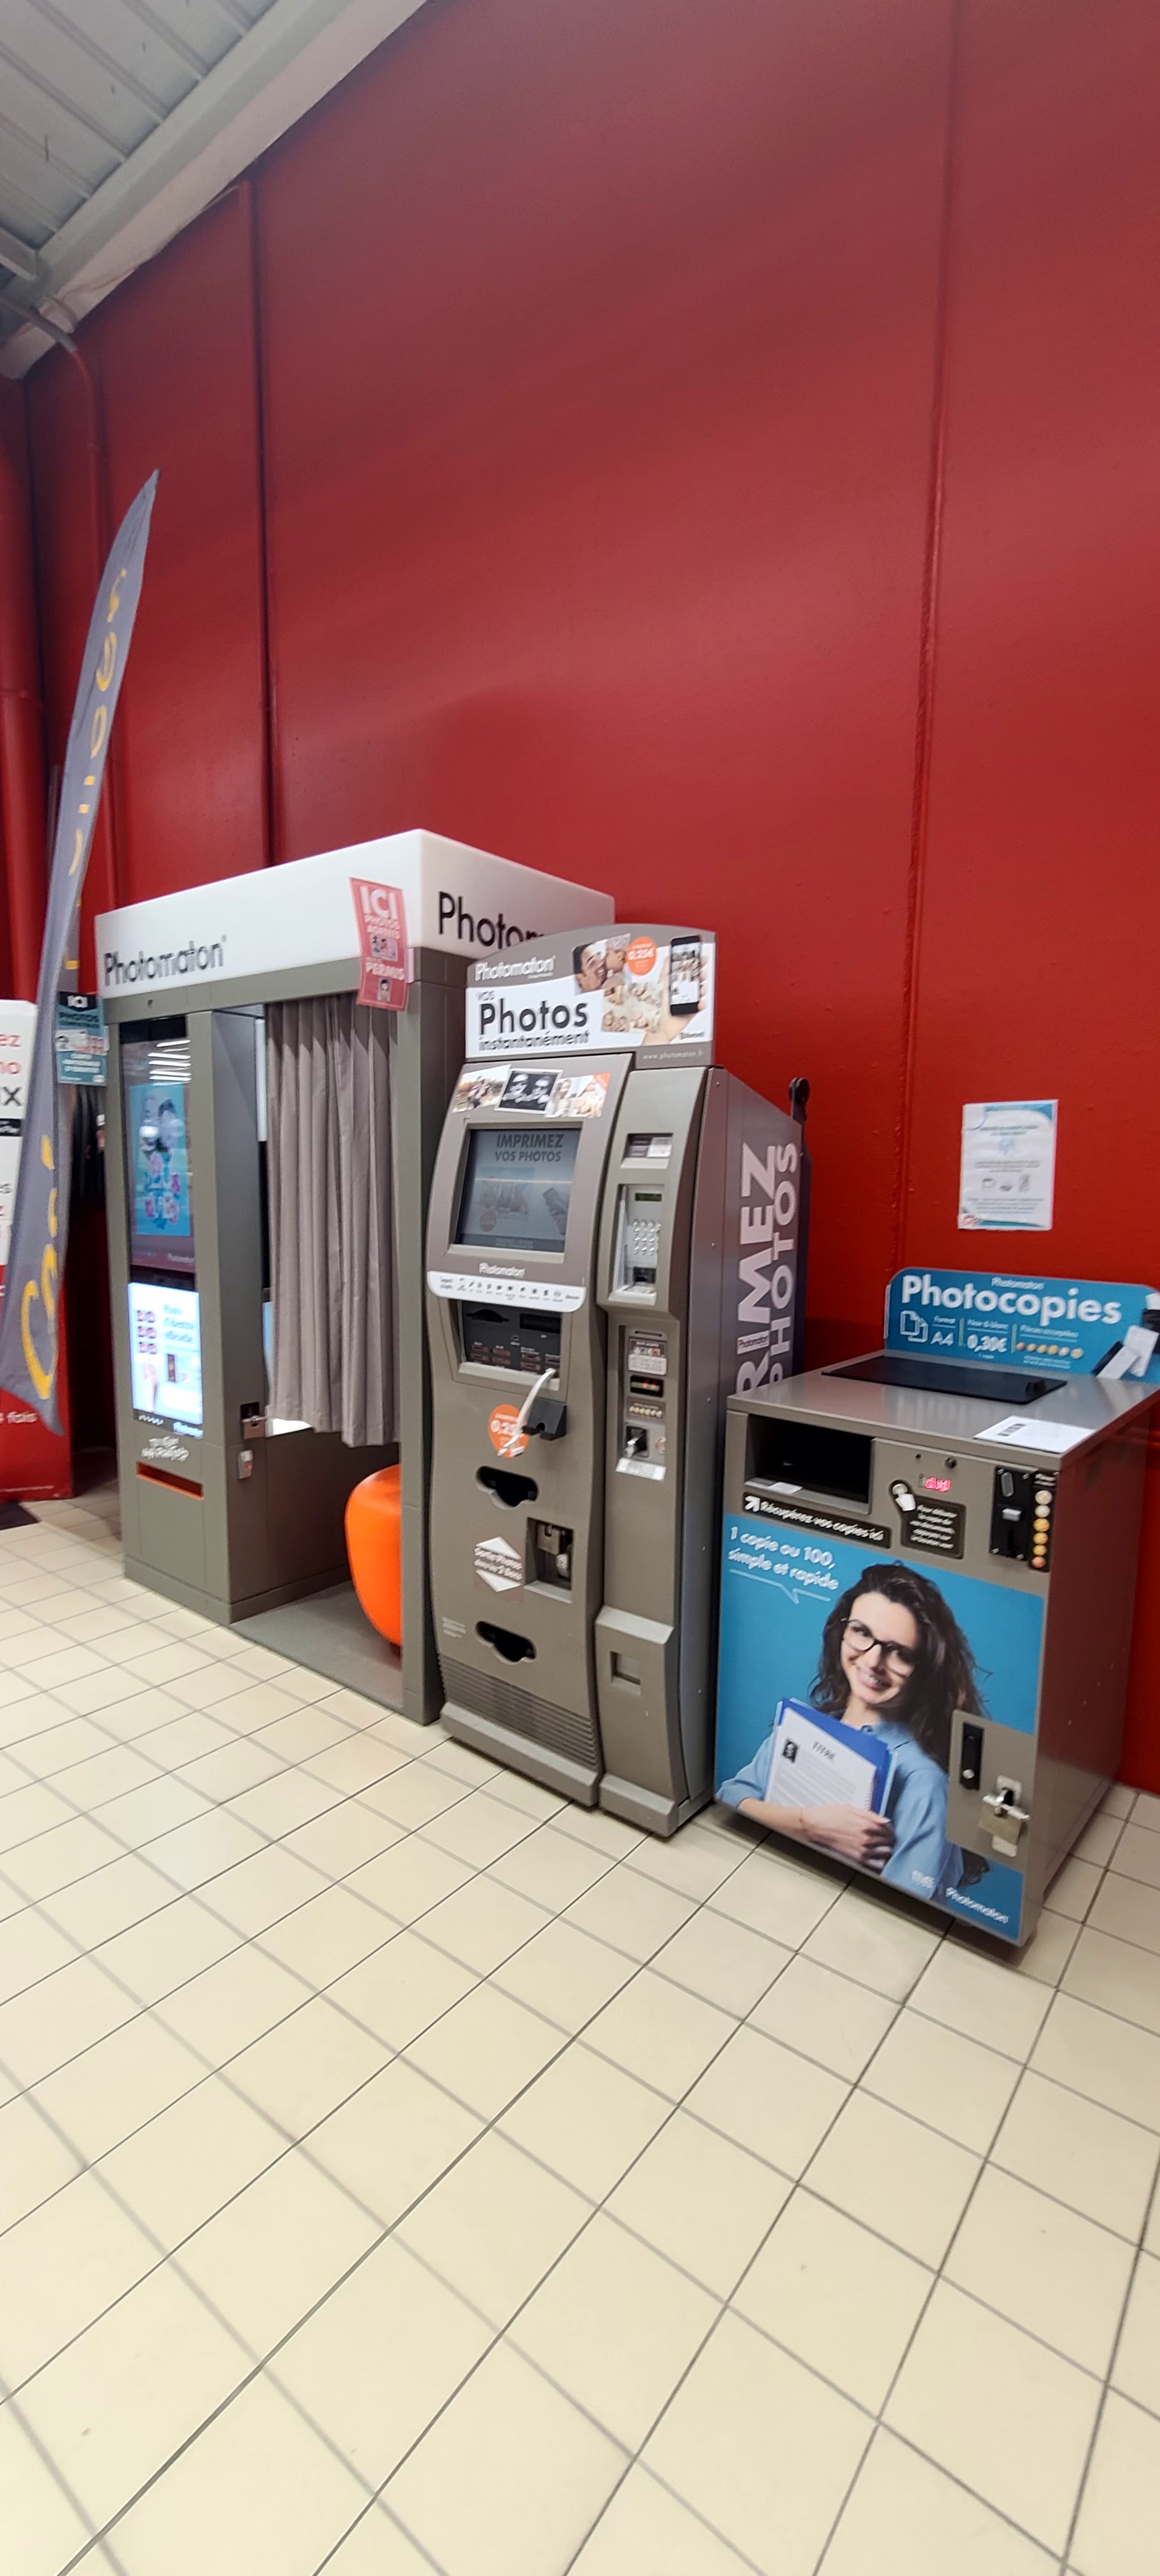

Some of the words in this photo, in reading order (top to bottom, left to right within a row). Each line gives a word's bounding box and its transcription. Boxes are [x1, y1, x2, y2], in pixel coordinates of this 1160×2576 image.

[360, 885, 398, 921] ICI
[104, 940, 224, 987] Photomaton
[475, 957, 555, 981] Photomaton
[480, 997, 588, 1035] Photos
[478, 1030, 590, 1052] instantanément
[496, 1133, 564, 1149] IMPRIMEZ
[495, 1151, 515, 1162] VOS
[518, 1151, 561, 1162] PHOTOS
[901, 1273, 1122, 1327] Photocopies
[930, 1331, 954, 1347] A4
[832, 1522, 869, 1537] copies
[730, 1526, 738, 1540] 1
[740, 1533, 779, 1551] copie
[779, 1544, 801, 1558] ou
[804, 1546, 836, 1570] 100,
[728, 1547, 773, 1570] simple
[773, 1563, 790, 1575] et
[789, 1570, 839, 1591] rapide
